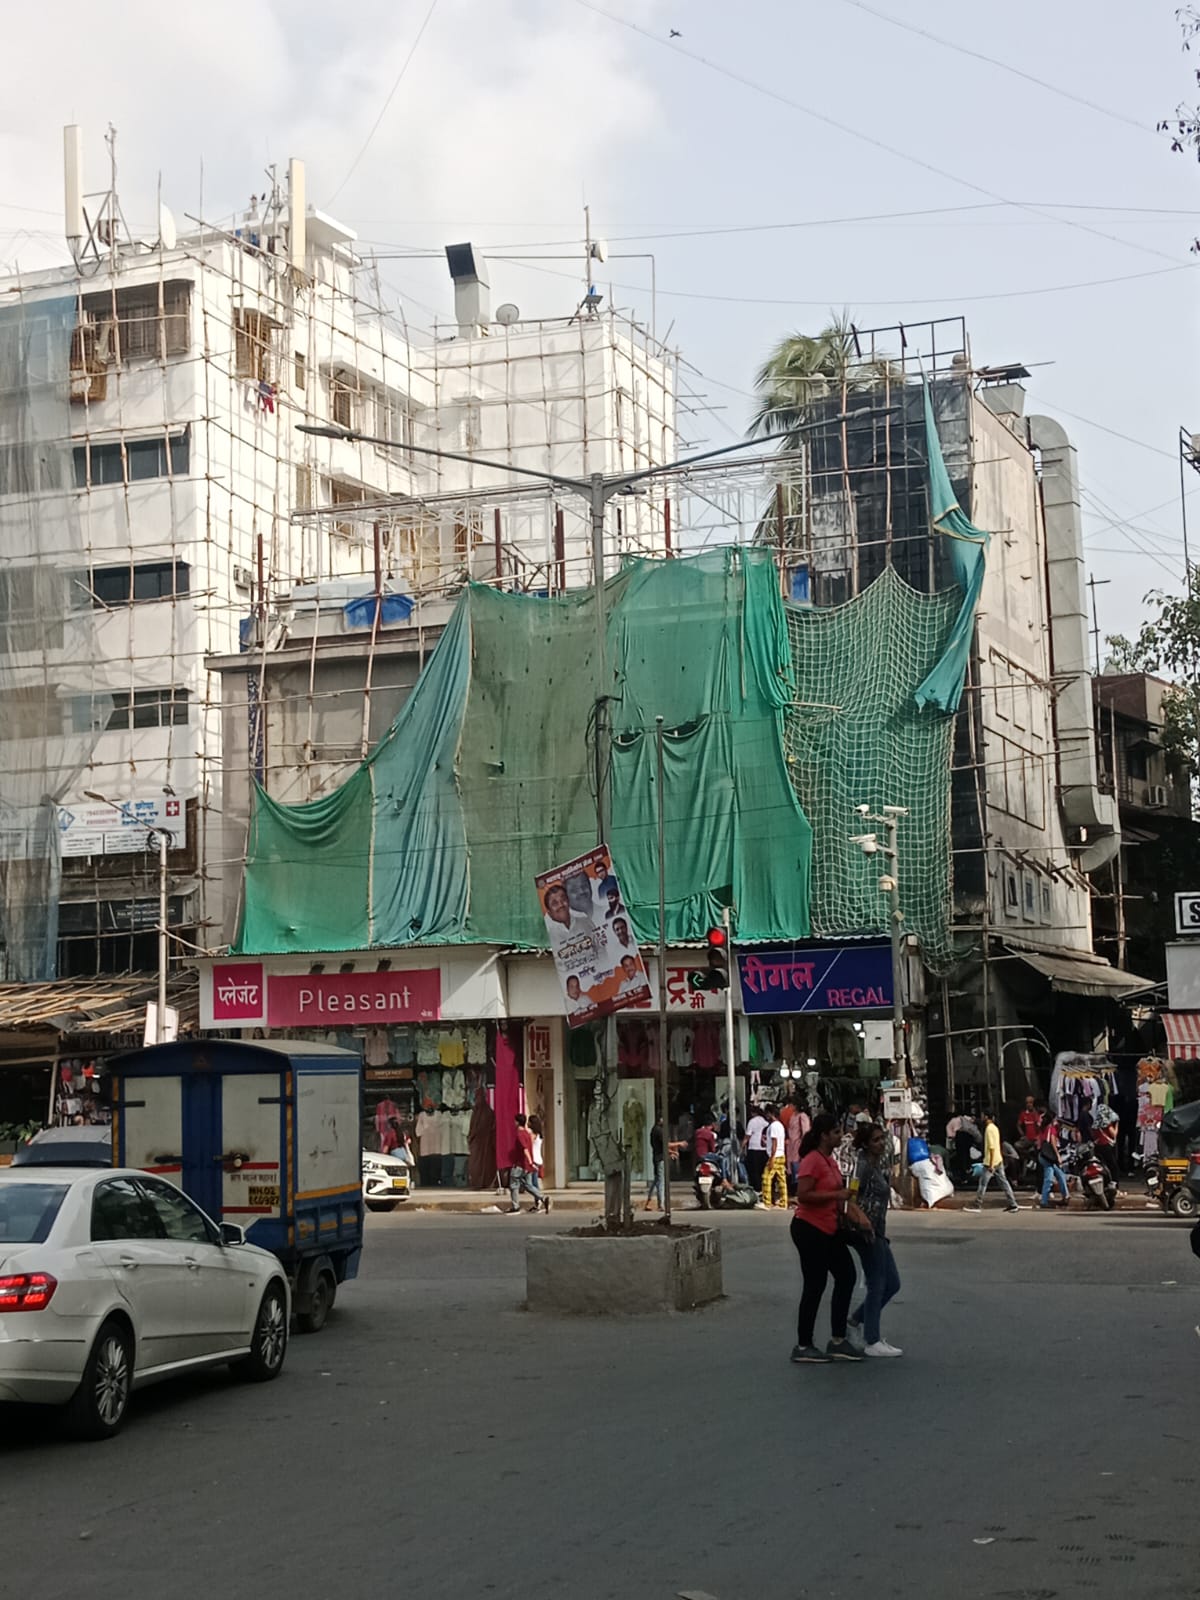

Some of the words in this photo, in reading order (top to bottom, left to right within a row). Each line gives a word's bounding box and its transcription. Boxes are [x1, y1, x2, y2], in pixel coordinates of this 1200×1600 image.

[666, 966, 721, 1004] ट्रा
[742, 955, 815, 994] रीगल
[217, 977, 259, 1006] प्लेजंट
[299, 985, 412, 1013] Pleasant
[689, 992, 705, 1009] मी
[826, 986, 890, 1008] REGAL
